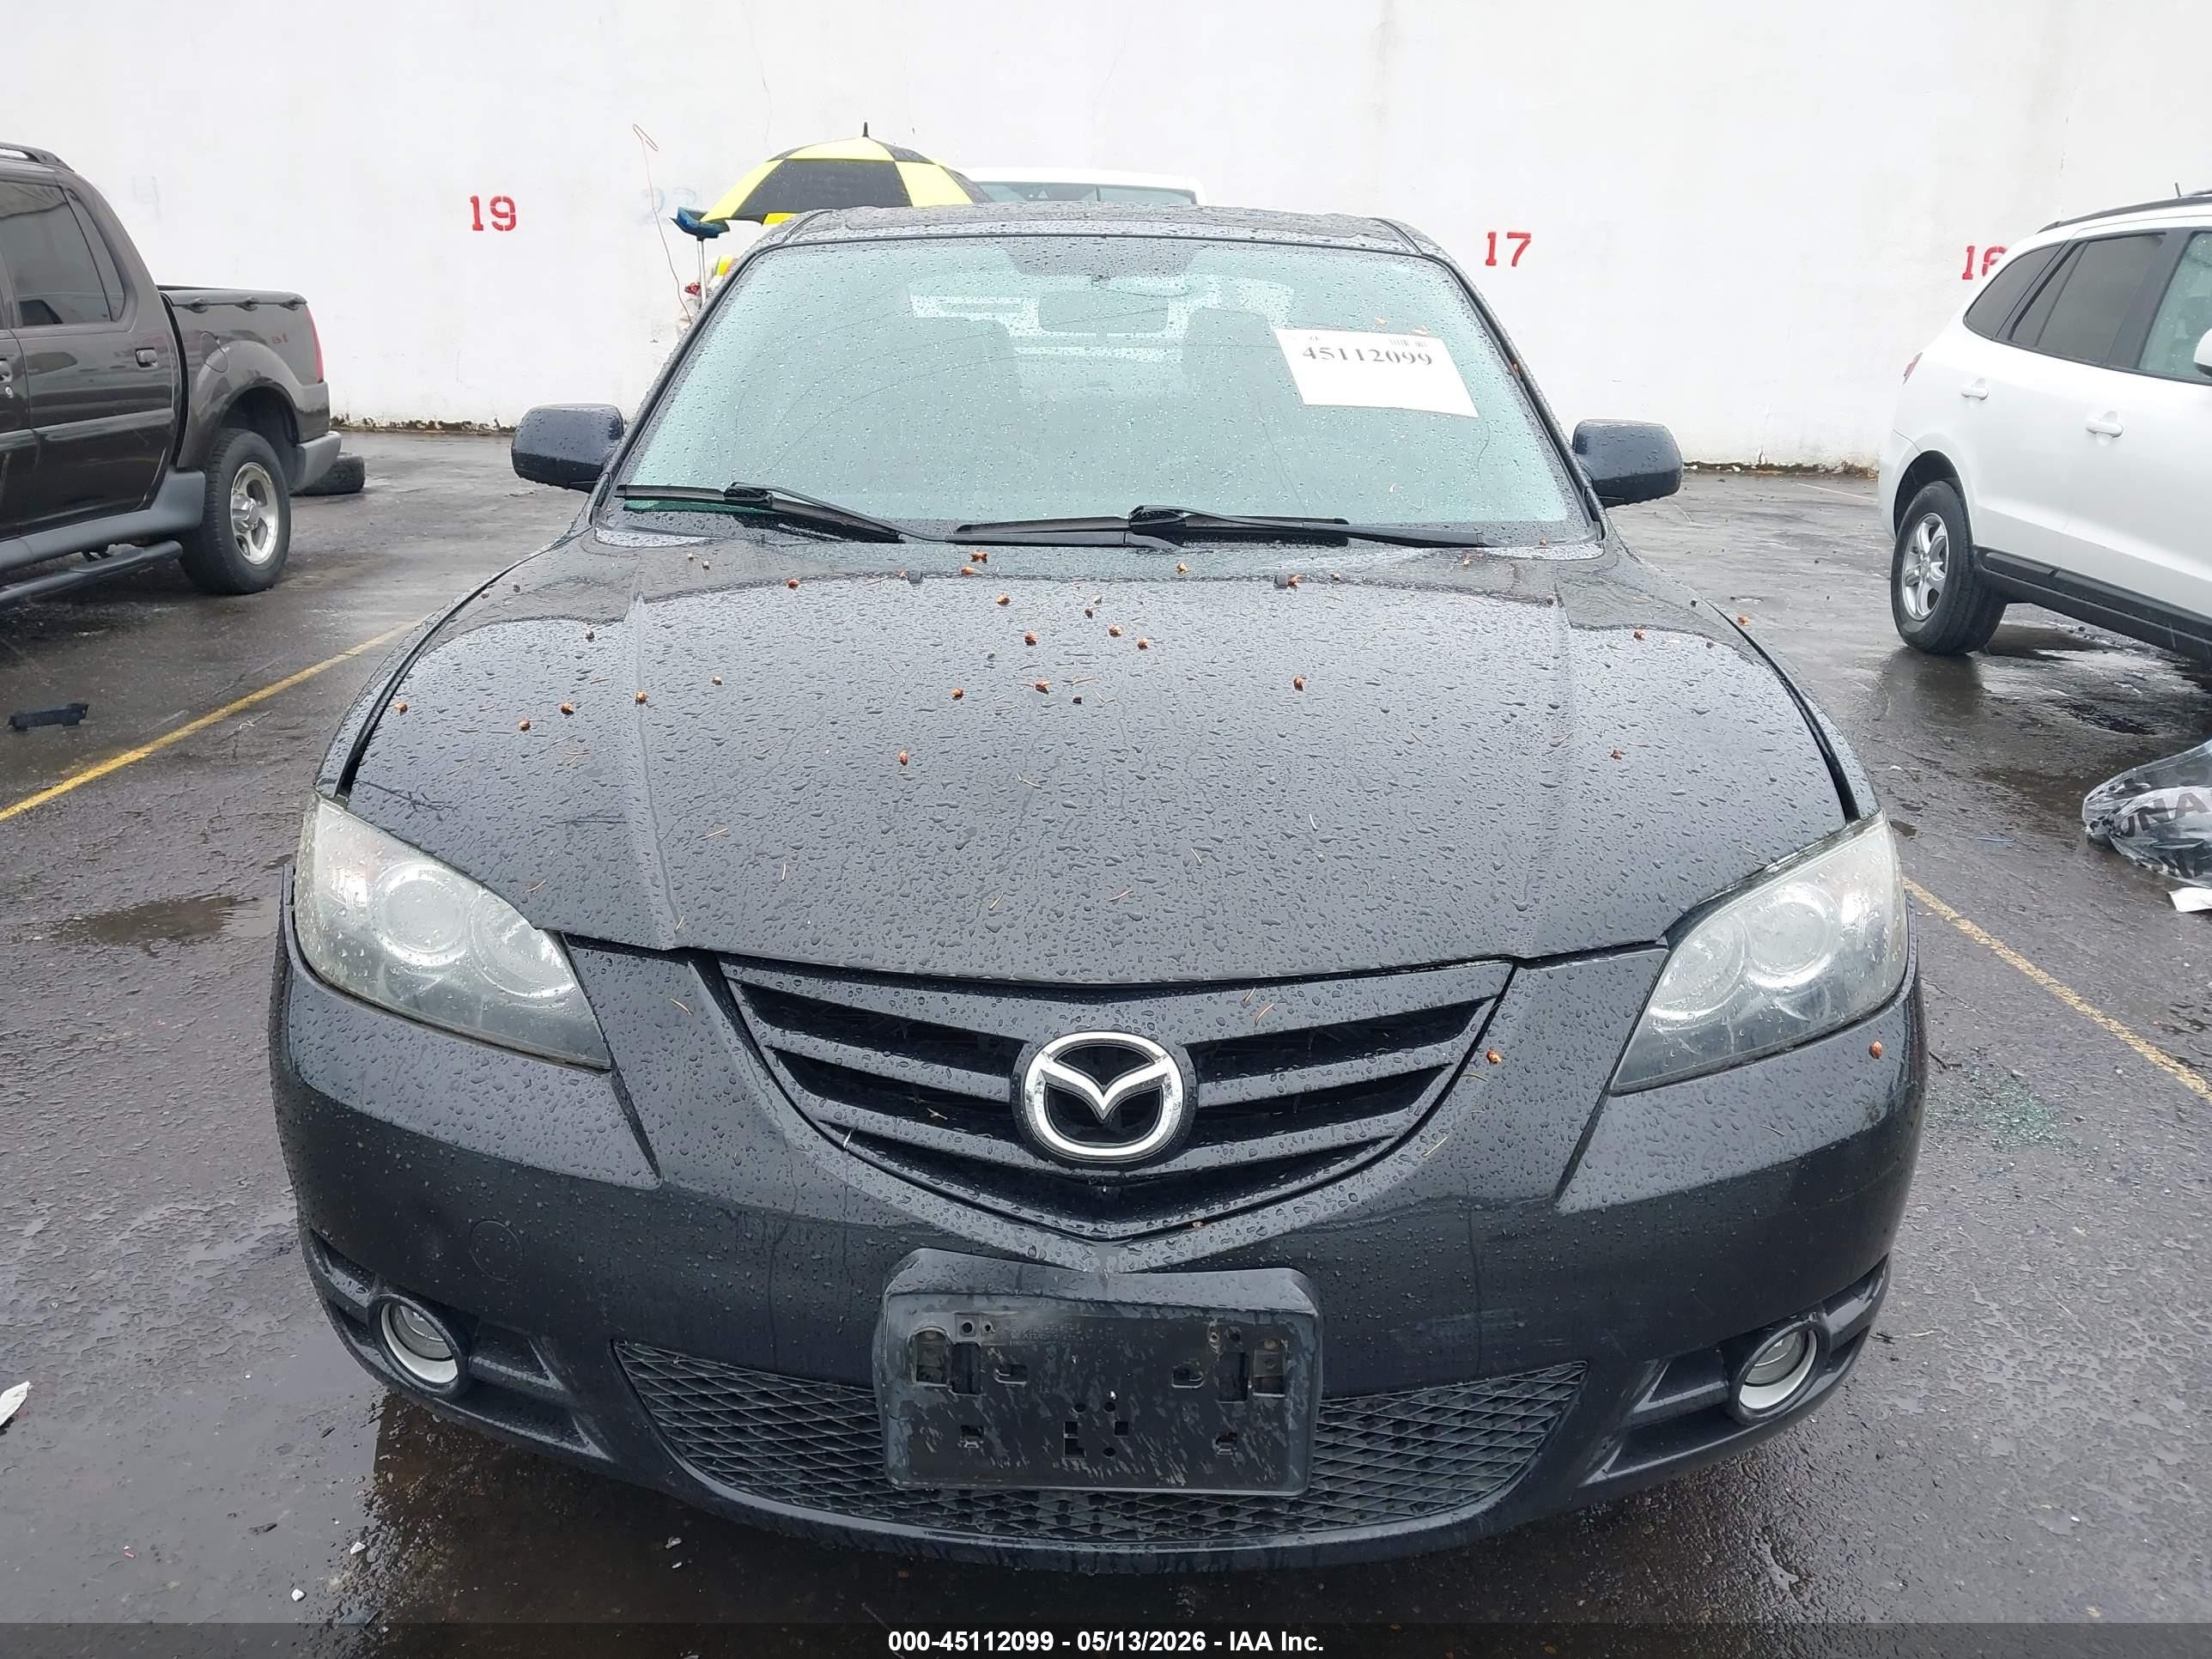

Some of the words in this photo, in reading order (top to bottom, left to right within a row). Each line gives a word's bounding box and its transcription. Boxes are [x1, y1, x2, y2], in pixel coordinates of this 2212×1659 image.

[471, 196, 517, 232] 19
[1485, 232, 1531, 267] 17
[1303, 346, 1432, 366] 45112099
